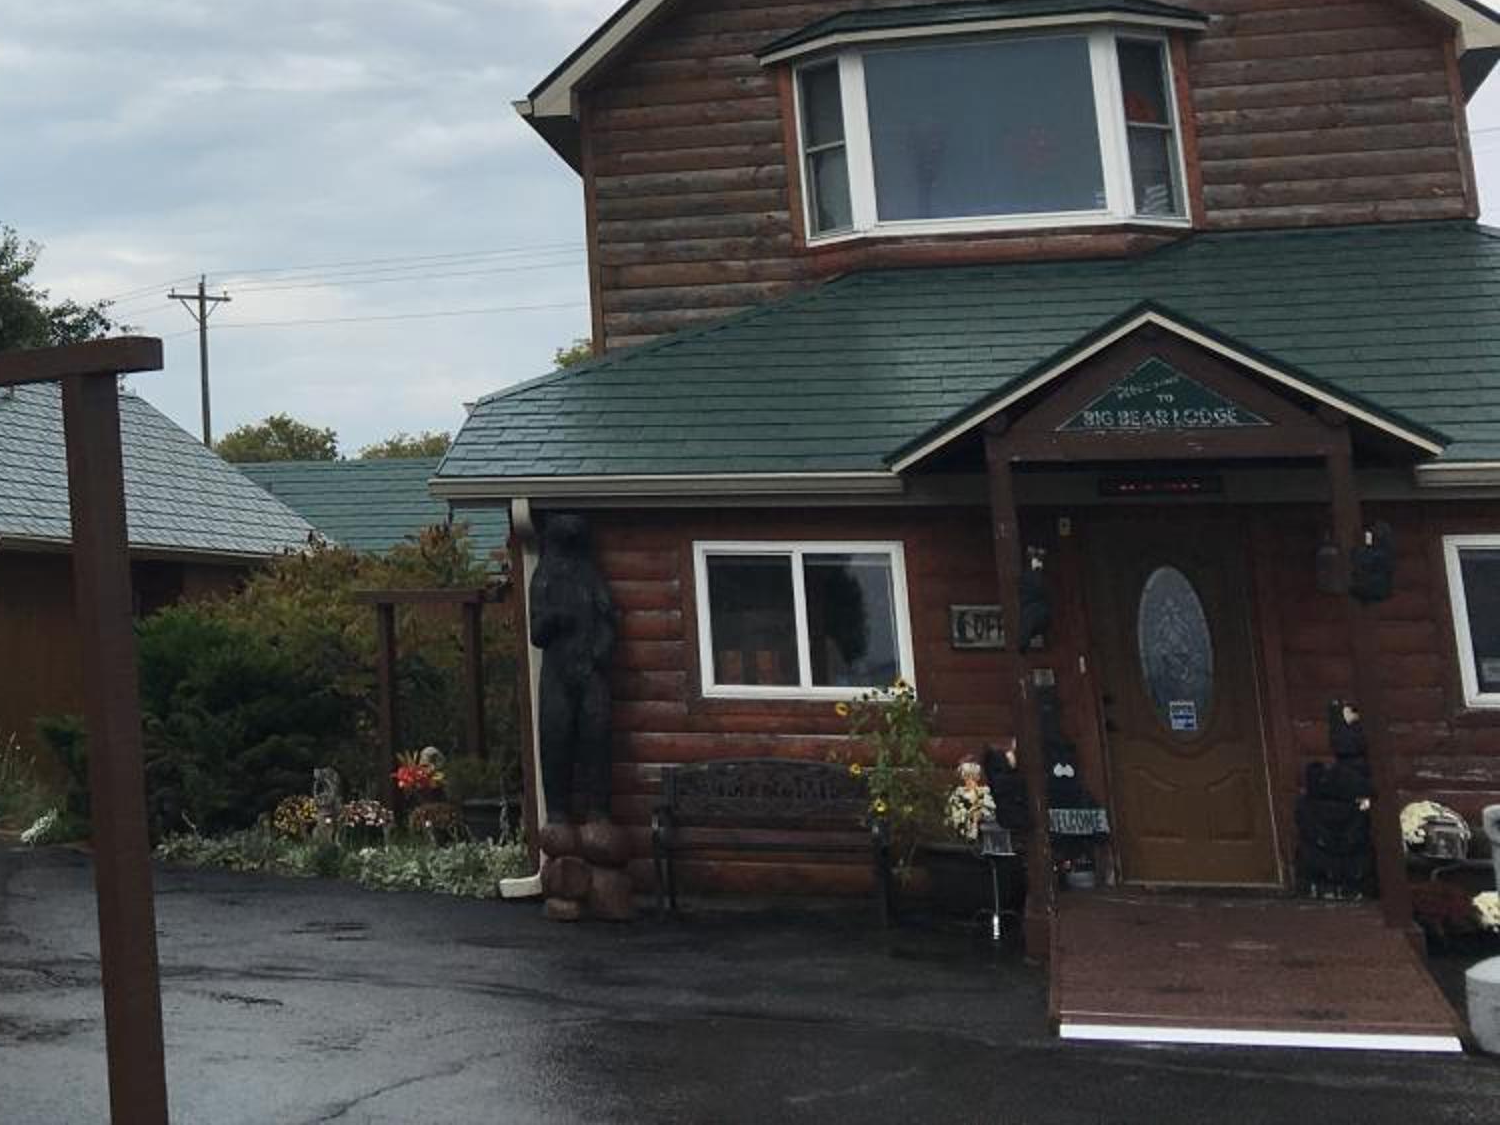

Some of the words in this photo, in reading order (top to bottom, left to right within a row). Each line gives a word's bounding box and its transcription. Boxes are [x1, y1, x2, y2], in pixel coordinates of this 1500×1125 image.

[1083, 410, 1115, 426] BIG
[1118, 409, 1169, 426] BEAR
[1173, 407, 1237, 425] LODGE
